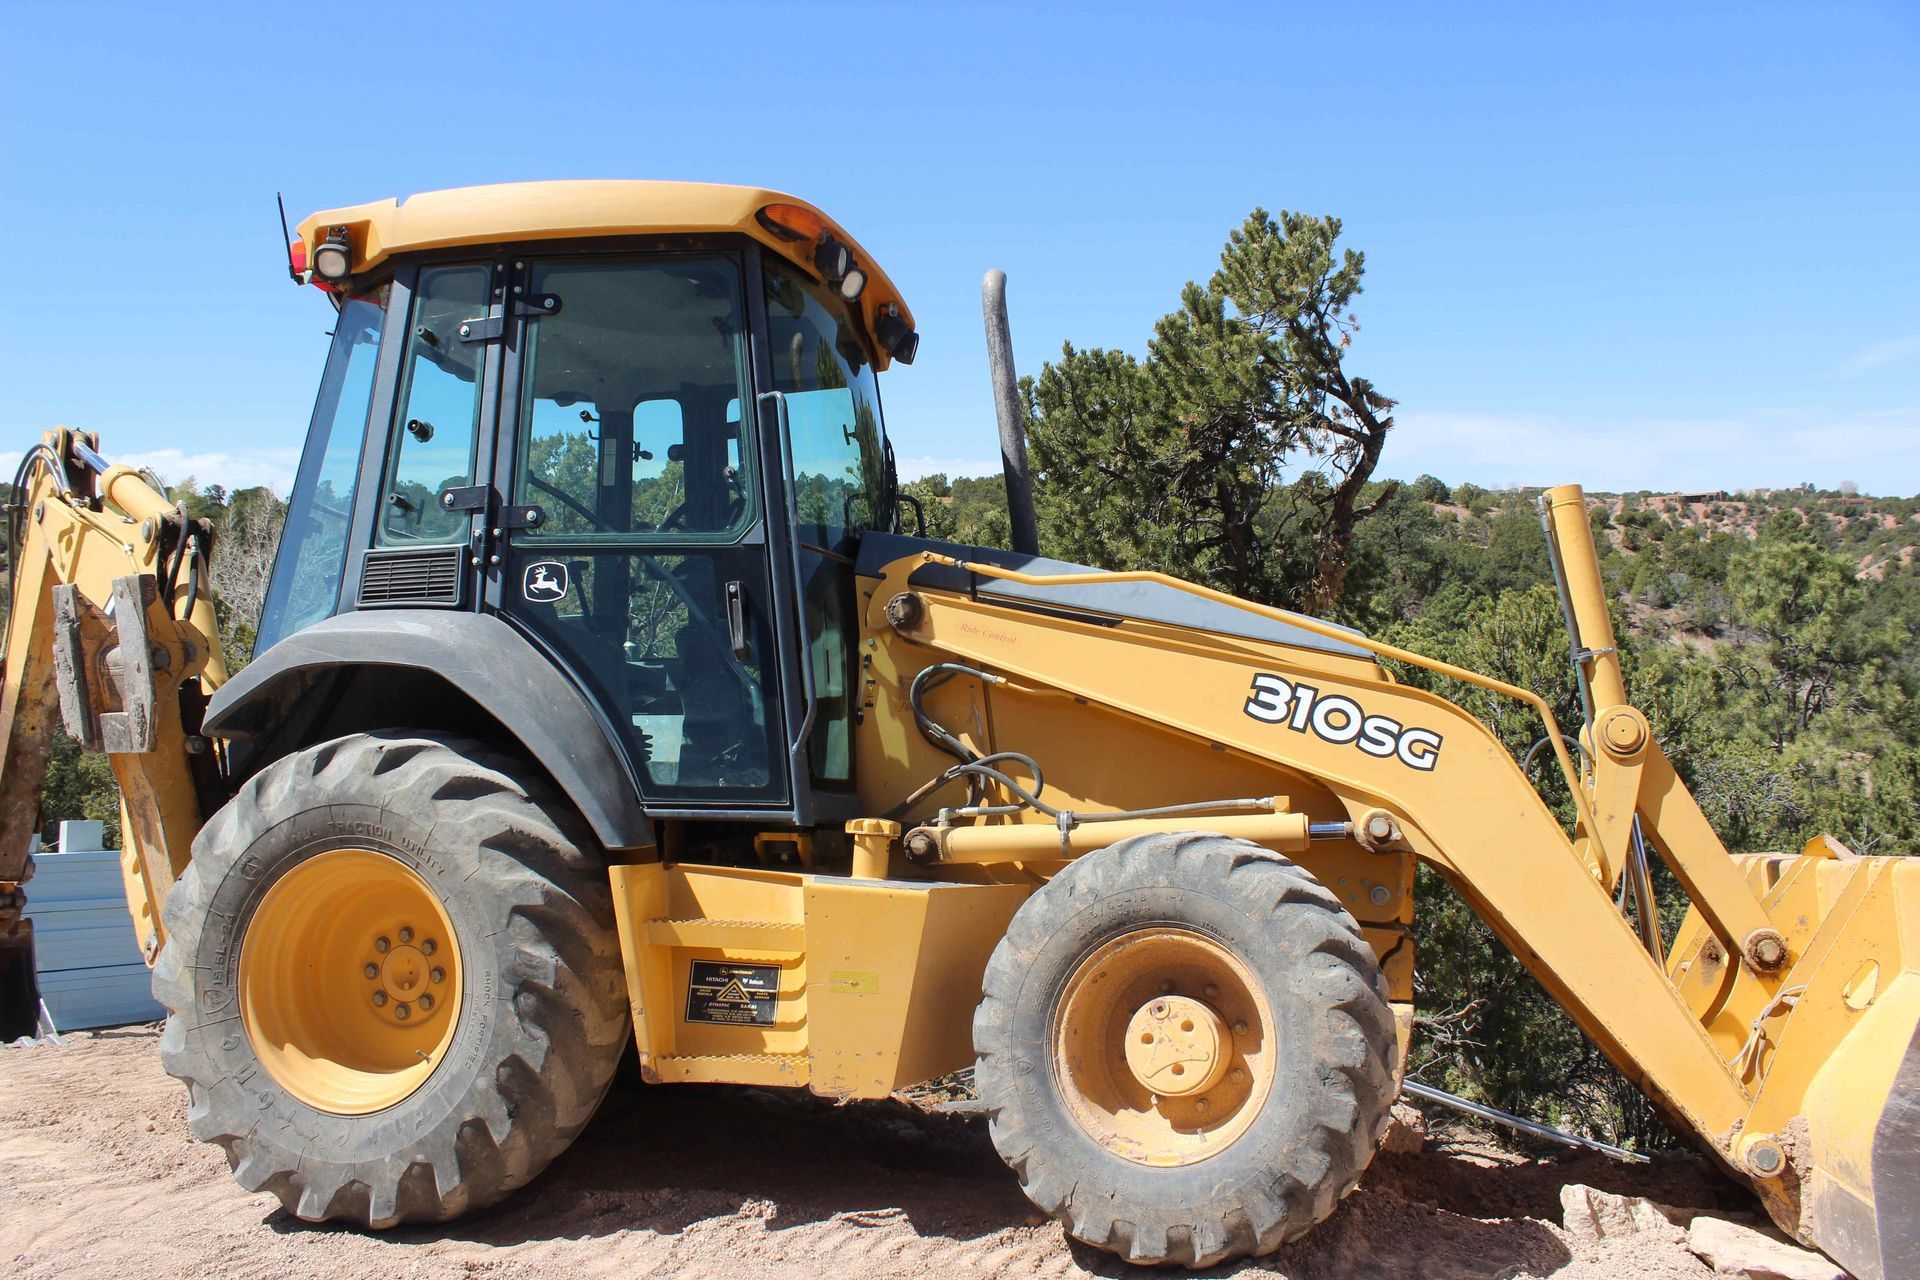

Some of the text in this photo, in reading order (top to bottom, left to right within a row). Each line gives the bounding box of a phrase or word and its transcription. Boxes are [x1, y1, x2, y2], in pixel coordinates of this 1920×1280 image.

[960, 623, 1017, 645] Ride Control
[1243, 672, 1444, 772] 310SG
[402, 836, 445, 875] UTILITY
